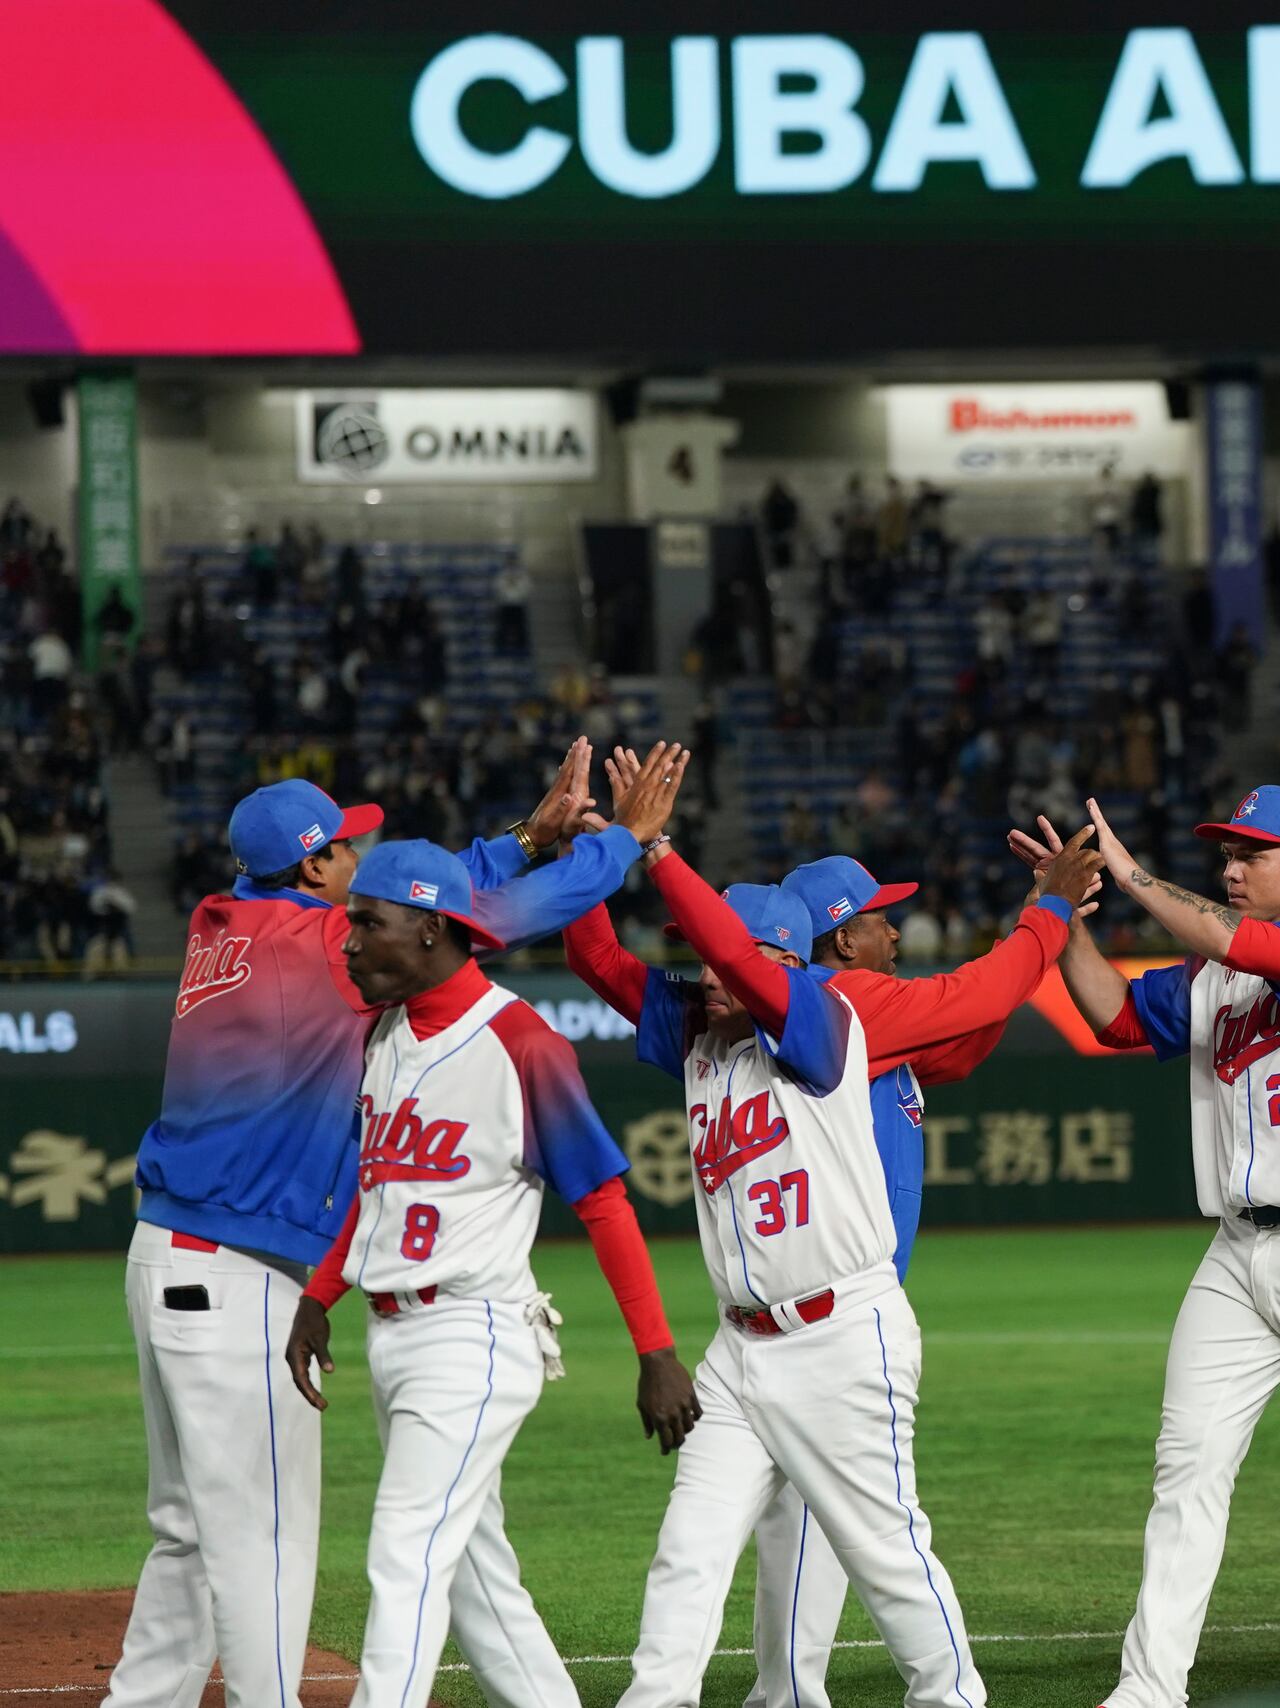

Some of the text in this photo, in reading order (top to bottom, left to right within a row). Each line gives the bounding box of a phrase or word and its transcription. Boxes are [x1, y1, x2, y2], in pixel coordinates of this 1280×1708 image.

[409, 32, 1037, 198] CUBA
[405, 427, 584, 463] OMNIA
[668, 444, 694, 486] 4
[689, 1090, 790, 1189] Cuba
[922, 1109, 1132, 1186] 工務店
[400, 1203, 440, 1262] 8
[747, 1168, 809, 1238] 37
